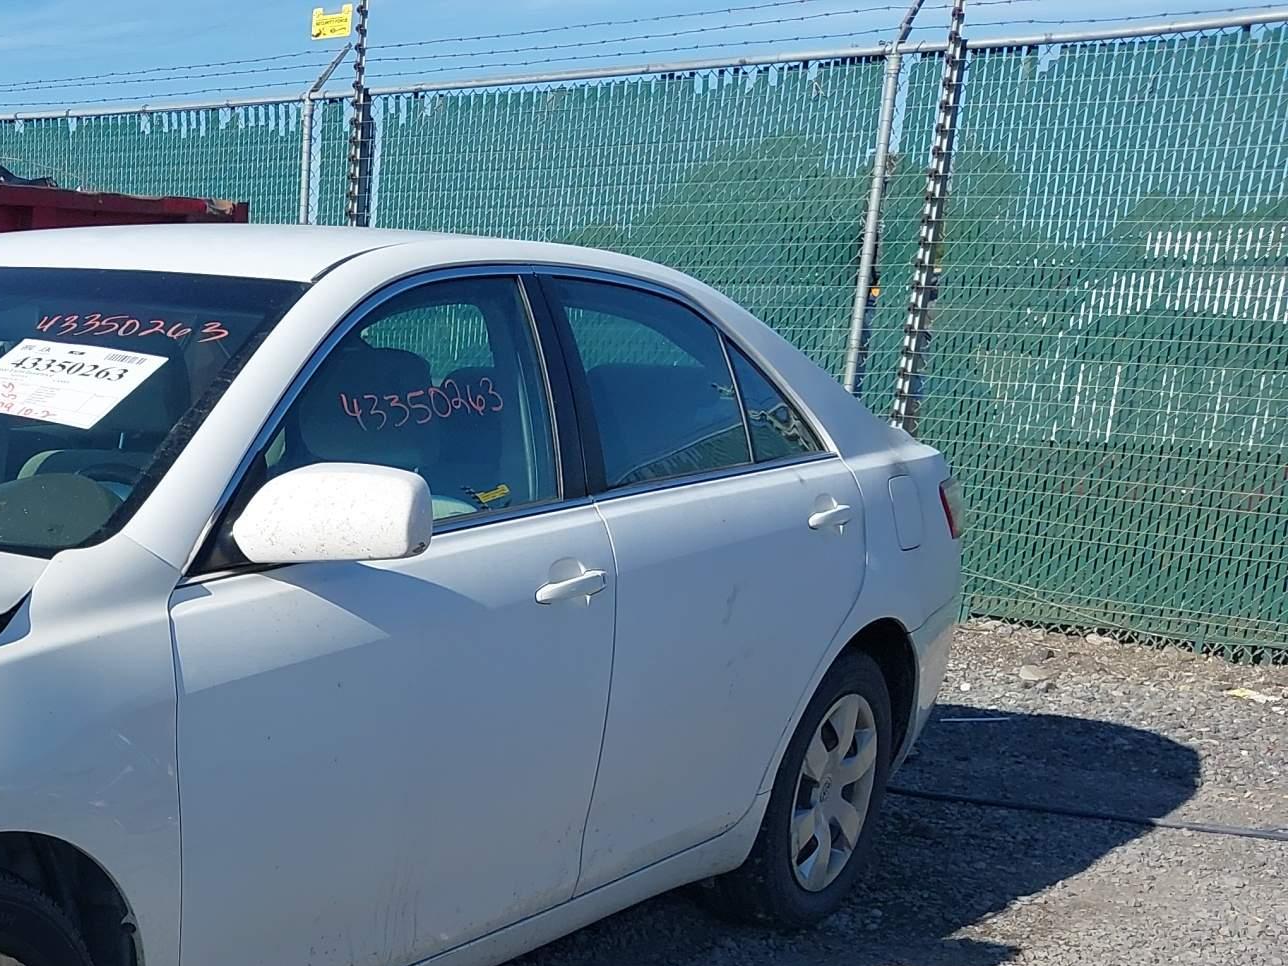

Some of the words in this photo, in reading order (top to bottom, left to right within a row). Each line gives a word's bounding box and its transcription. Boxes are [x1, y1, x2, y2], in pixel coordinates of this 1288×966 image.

[36, 313, 229, 343] 43350263
[11, 356, 130, 382] 43350263
[340, 377, 504, 431] 43350263
